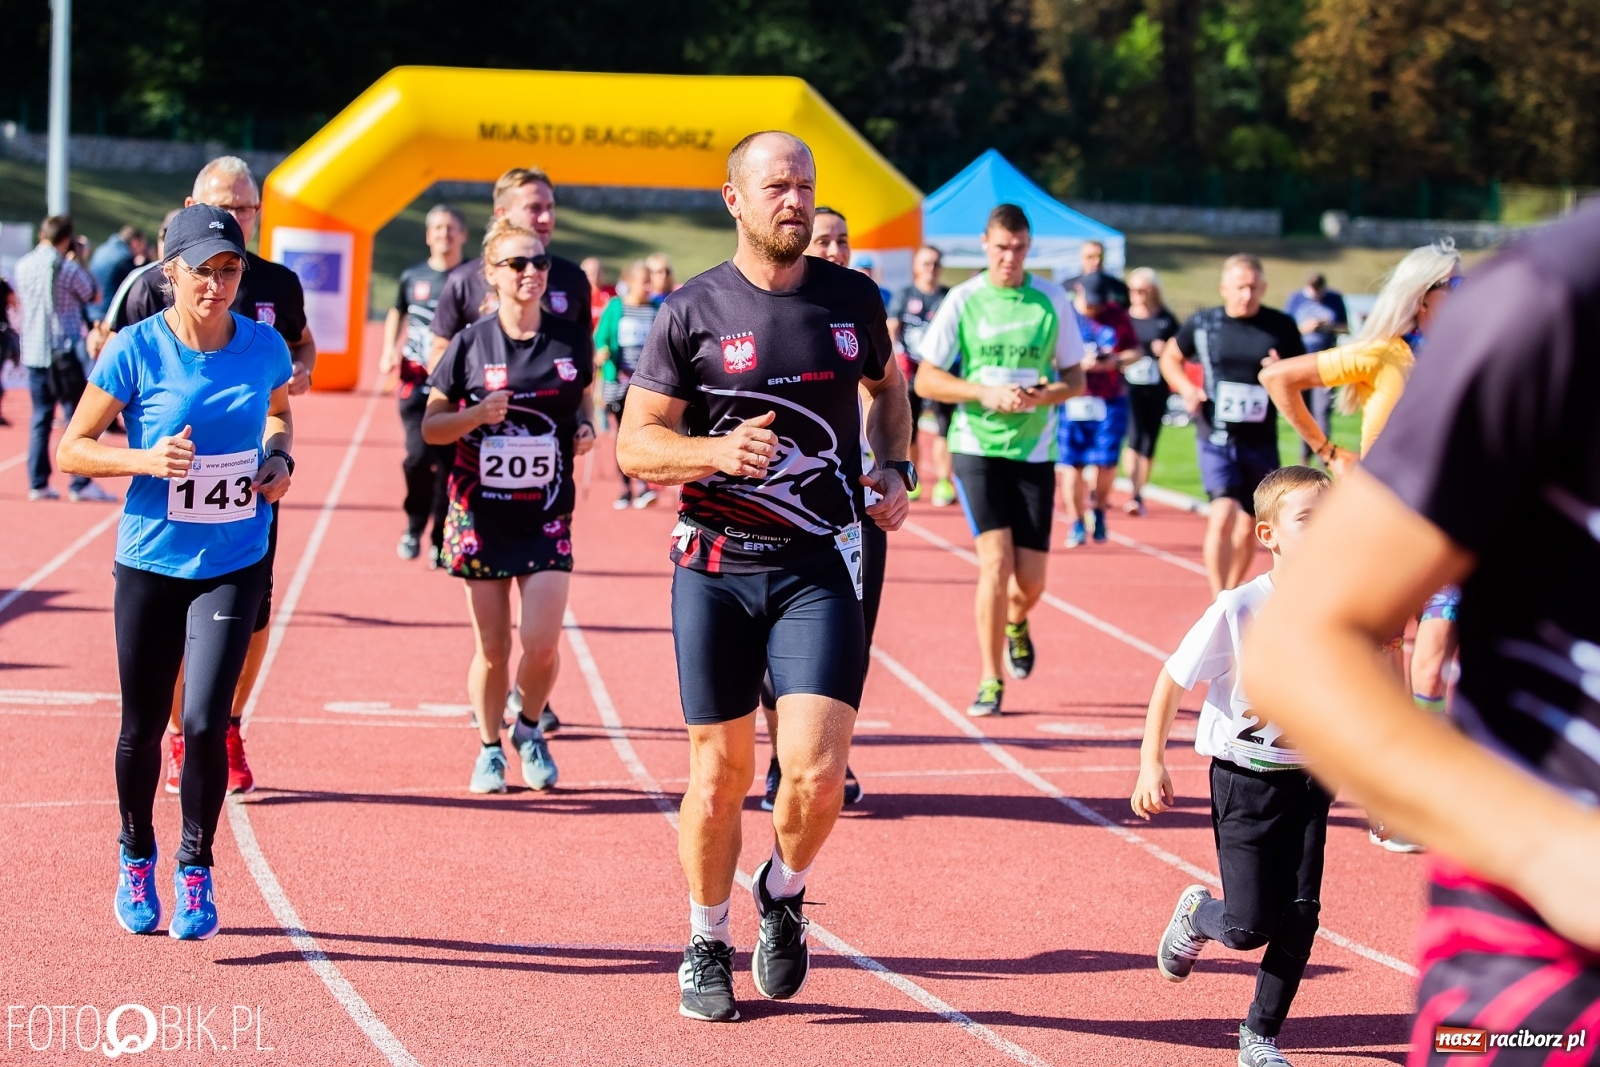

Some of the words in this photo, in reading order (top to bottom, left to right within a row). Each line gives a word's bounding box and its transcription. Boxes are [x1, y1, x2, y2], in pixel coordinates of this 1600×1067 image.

[479, 121, 576, 146] MIASTO
[582, 126, 715, 151] RACIBÓRZ
[720, 331, 753, 341] POLSKA
[981, 345, 1004, 356] JUST
[1010, 347, 1026, 358] DO
[1223, 396, 1263, 415] 215
[206, 457, 256, 469] www.personalbest.pl
[485, 455, 549, 478] 205
[176, 475, 253, 510] 143
